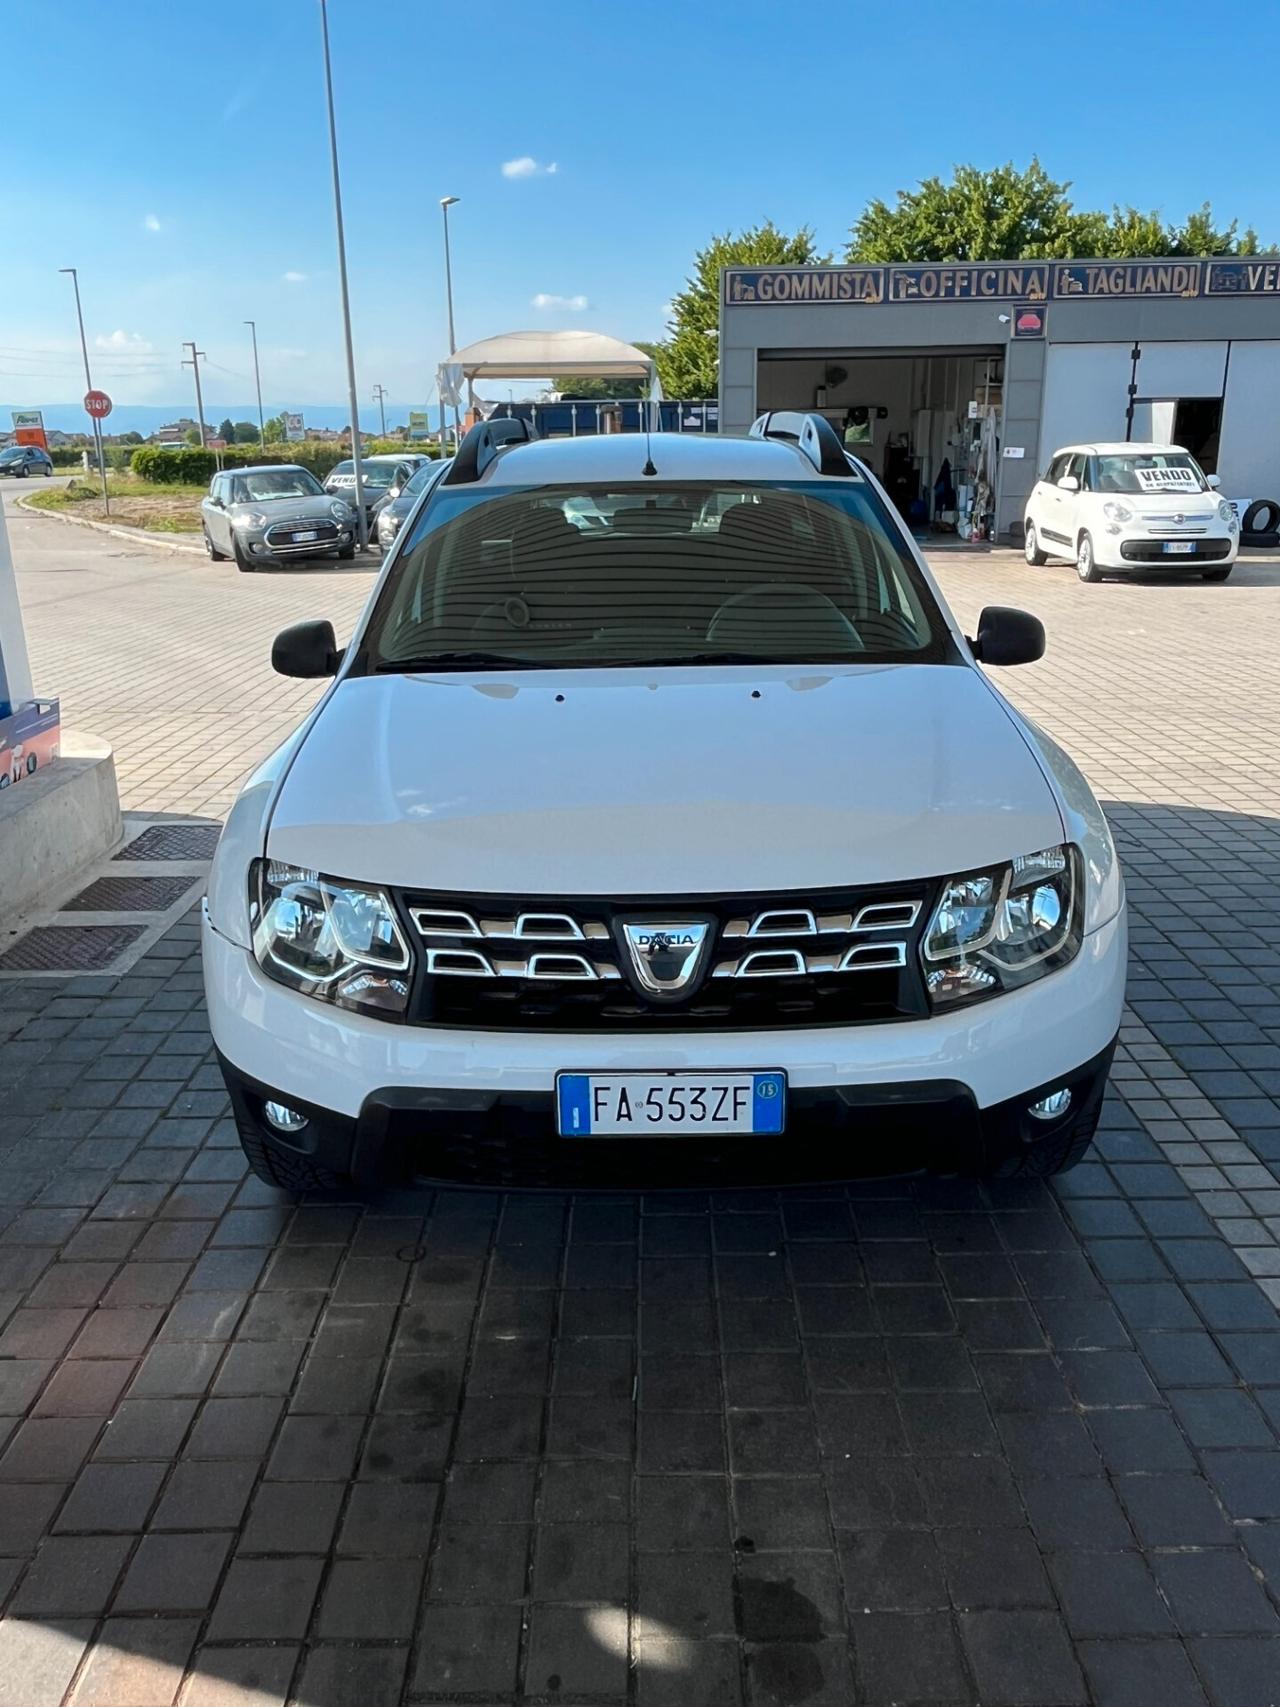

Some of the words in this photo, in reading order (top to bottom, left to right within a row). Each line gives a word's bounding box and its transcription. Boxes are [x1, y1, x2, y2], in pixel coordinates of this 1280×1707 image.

[757, 273, 877, 300] GOMMISTA
[920, 269, 1041, 297] OFFICINA
[1086, 266, 1198, 294] TAGLIANDI
[86, 399, 108, 410] STOP
[1140, 470, 1192, 482] VENDO
[639, 934, 694, 945] DACIA
[594, 1086, 632, 1121] FA
[646, 1086, 750, 1122] 553ZF
[762, 1083, 774, 1096] 15
